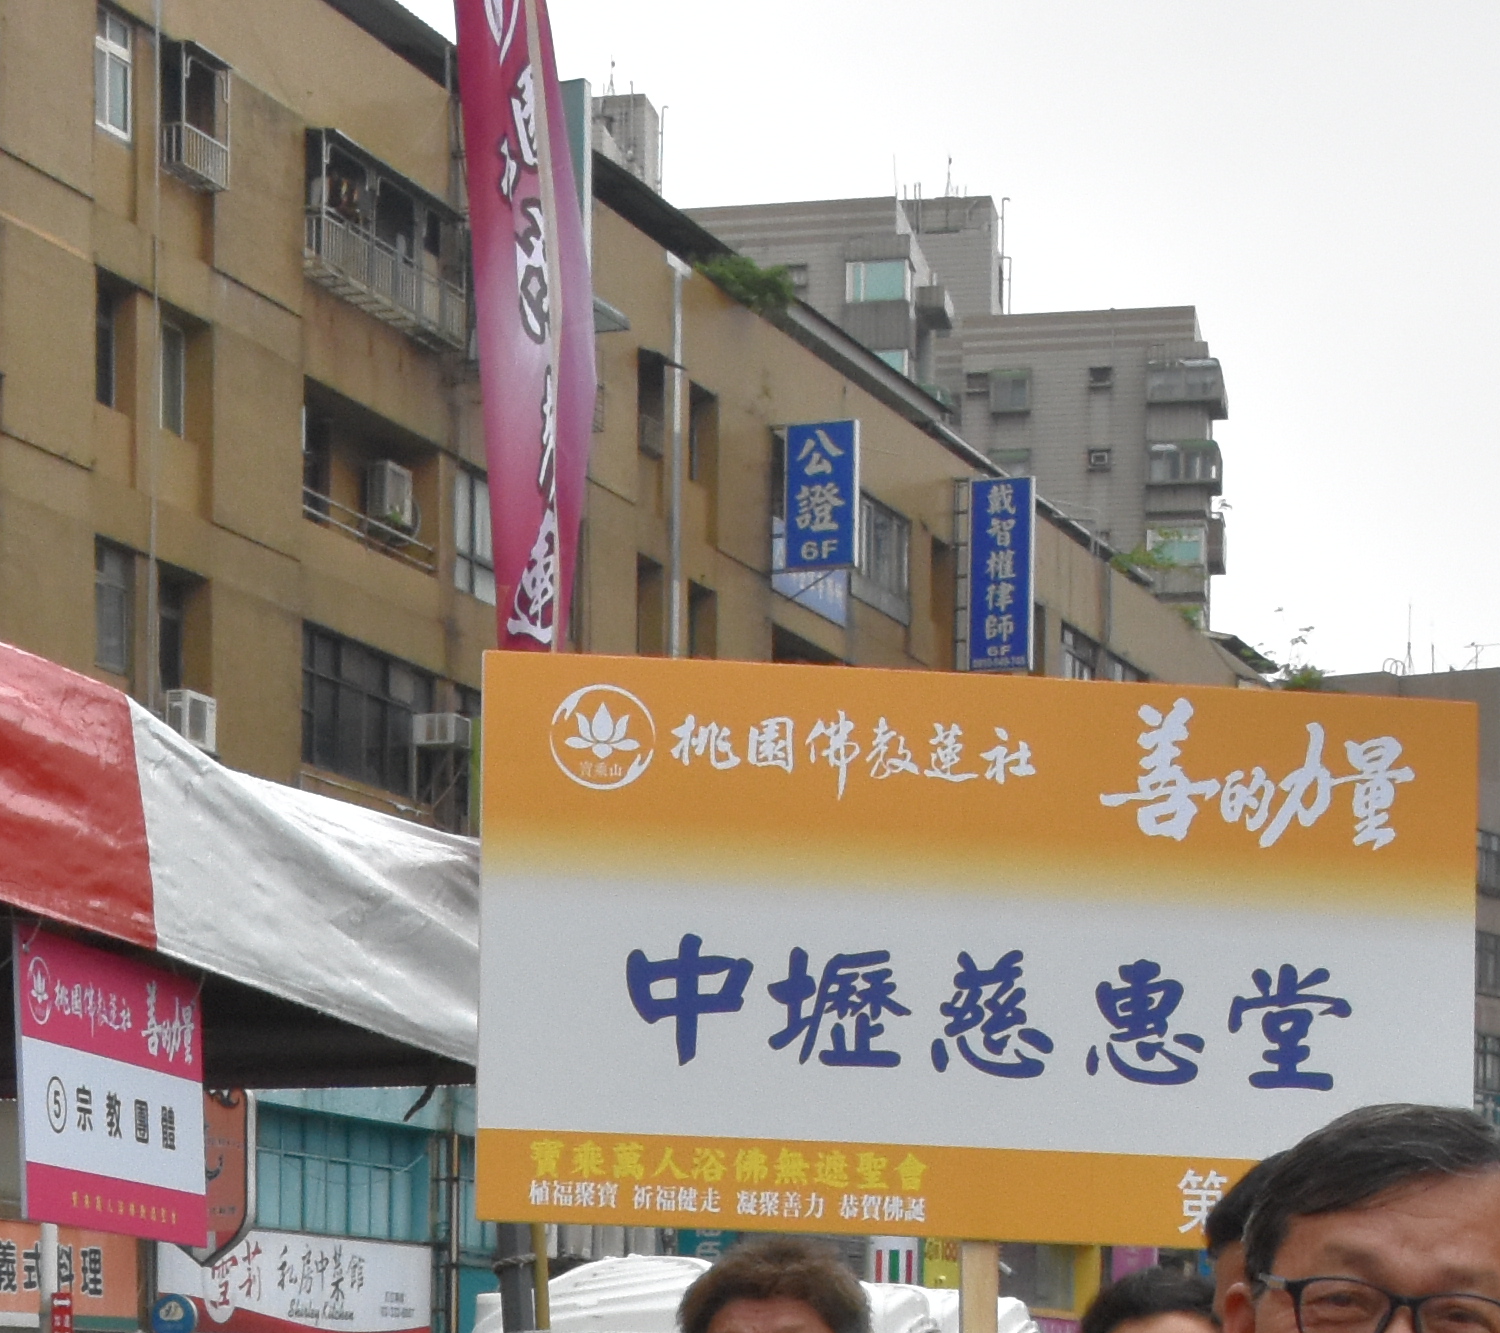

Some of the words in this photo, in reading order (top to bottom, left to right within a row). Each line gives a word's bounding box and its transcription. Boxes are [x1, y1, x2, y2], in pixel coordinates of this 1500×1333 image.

[795, 428, 845, 532] 公證
[800, 539, 839, 561] 6F
[669, 710, 1037, 800] 桃園佛教蓮社
[1099, 697, 1415, 850] 善的力量
[625, 932, 1353, 1093] 中壢慈惠堂
[75, 1085, 176, 1150] 宗教團體
[529, 1140, 930, 1192] 寶乘萬人浴佛無遮聖會
[632, 1184, 722, 1214] 祈福健走
[736, 1189, 826, 1220] 凝聚善力
[838, 1194, 928, 1223] 恭賀佛誕
